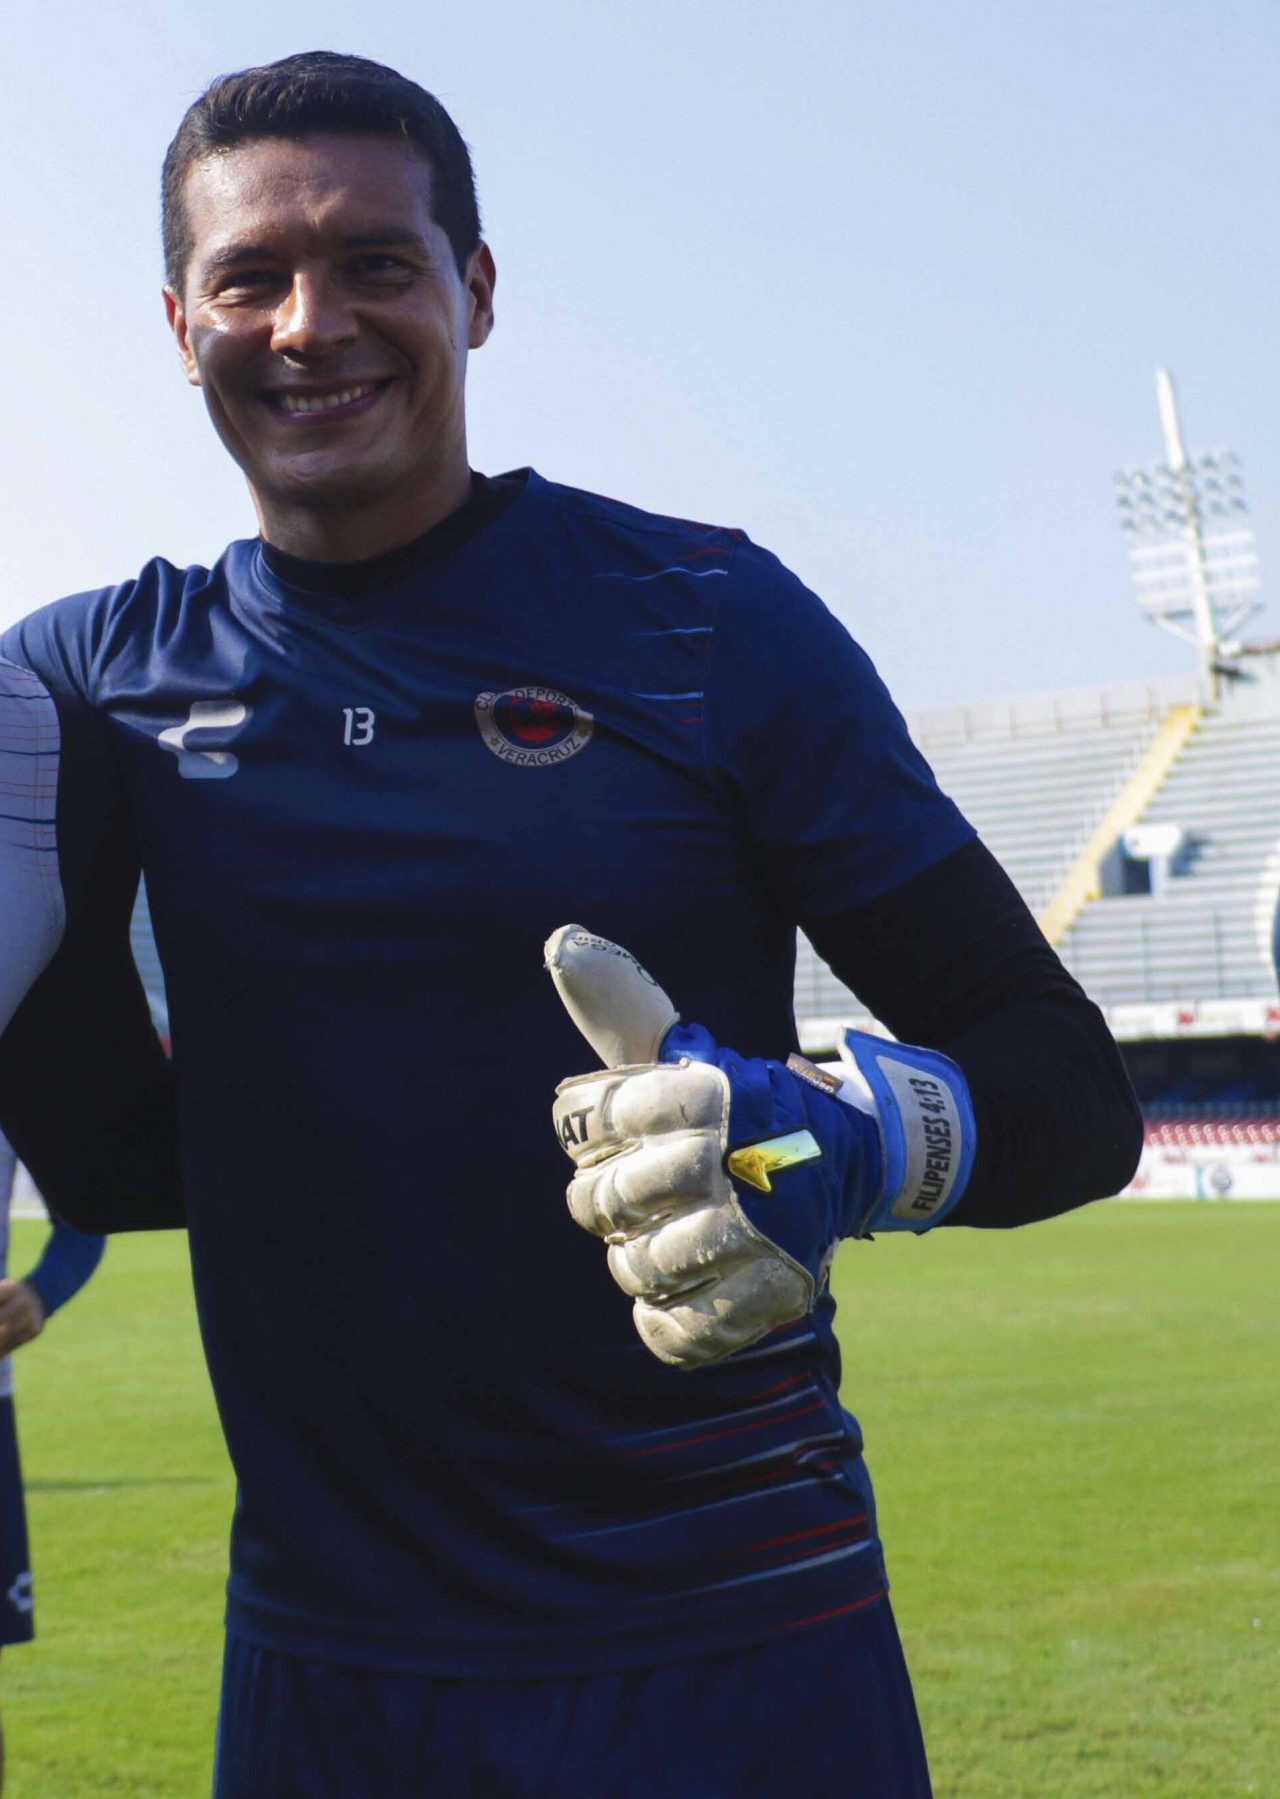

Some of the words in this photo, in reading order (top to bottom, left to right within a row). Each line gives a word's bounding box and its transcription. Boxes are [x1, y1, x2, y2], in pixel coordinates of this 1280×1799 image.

[342, 706, 376, 747] 13
[498, 737, 581, 765] VERACRUZ
[908, 1077, 946, 1114] 4:13
[911, 1116, 951, 1212] FILIPENSES
